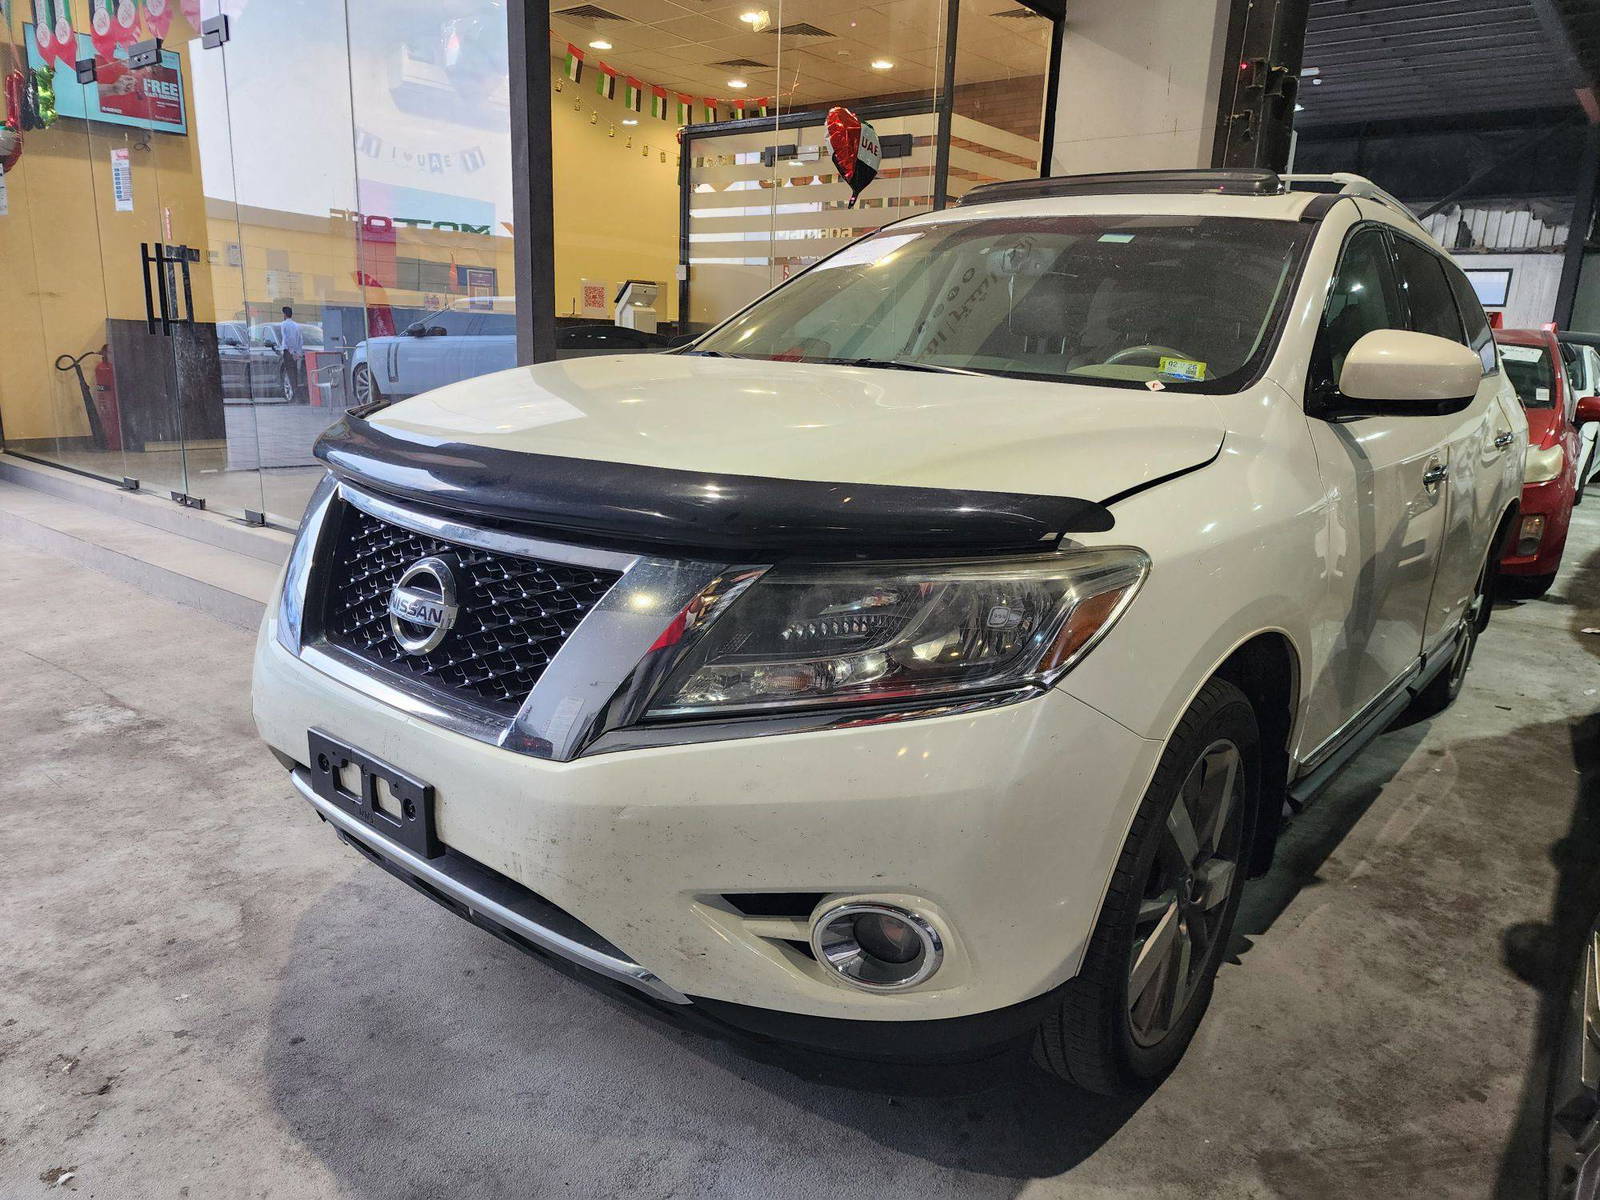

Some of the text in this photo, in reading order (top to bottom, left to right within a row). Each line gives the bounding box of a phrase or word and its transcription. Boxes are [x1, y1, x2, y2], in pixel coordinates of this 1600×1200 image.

[143, 79, 179, 96] FREE
[861, 136, 878, 156] UAE
[417, 153, 452, 169] UAE
[392, 595, 444, 624] NISSAN
